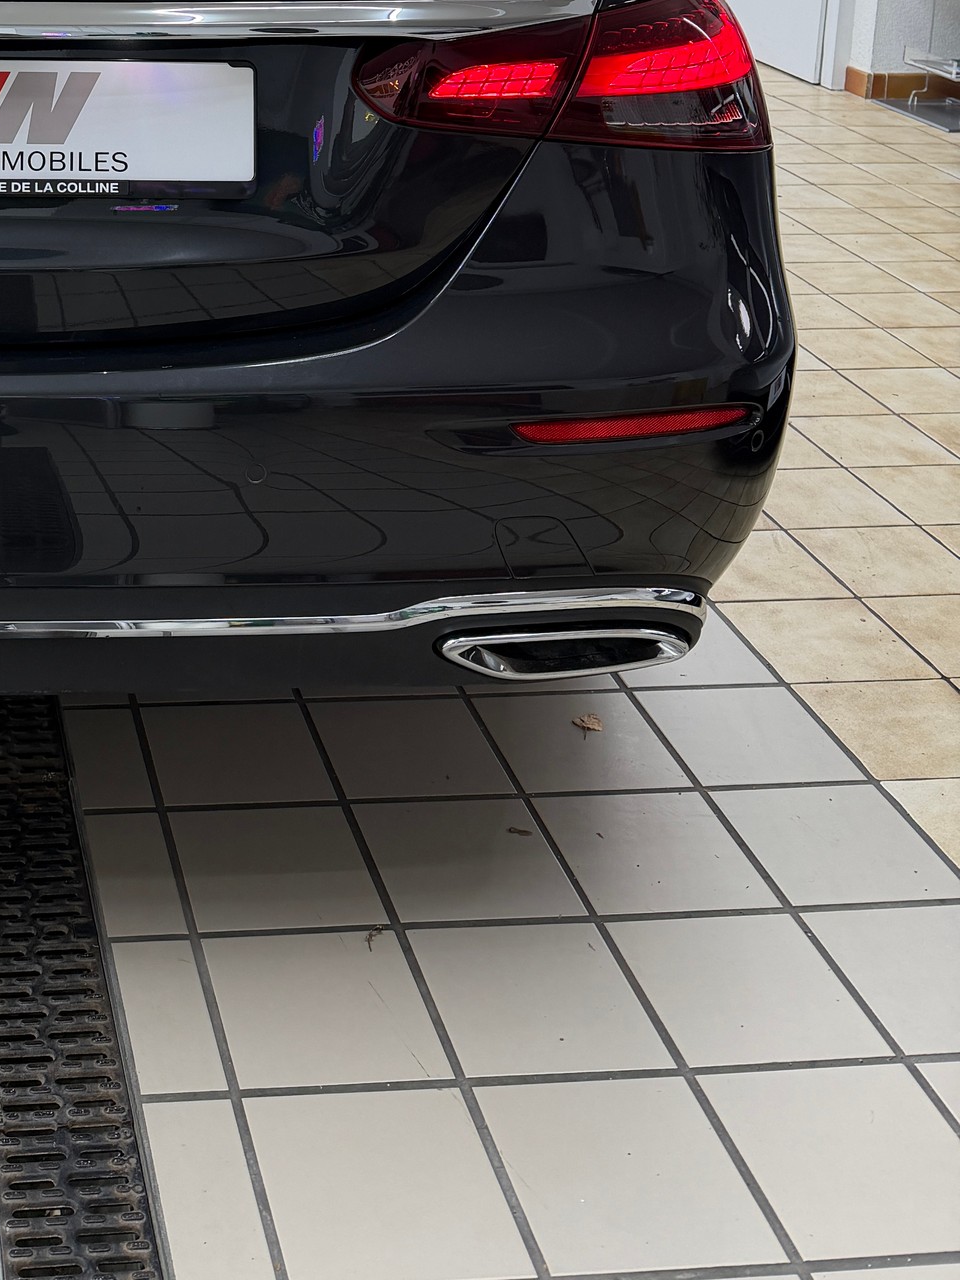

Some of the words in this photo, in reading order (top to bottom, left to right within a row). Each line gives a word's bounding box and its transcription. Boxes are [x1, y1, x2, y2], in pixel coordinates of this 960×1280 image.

[11, 181, 31, 193] DE
[35, 182, 54, 193] LA
[56, 182, 119, 193] COLLINE
